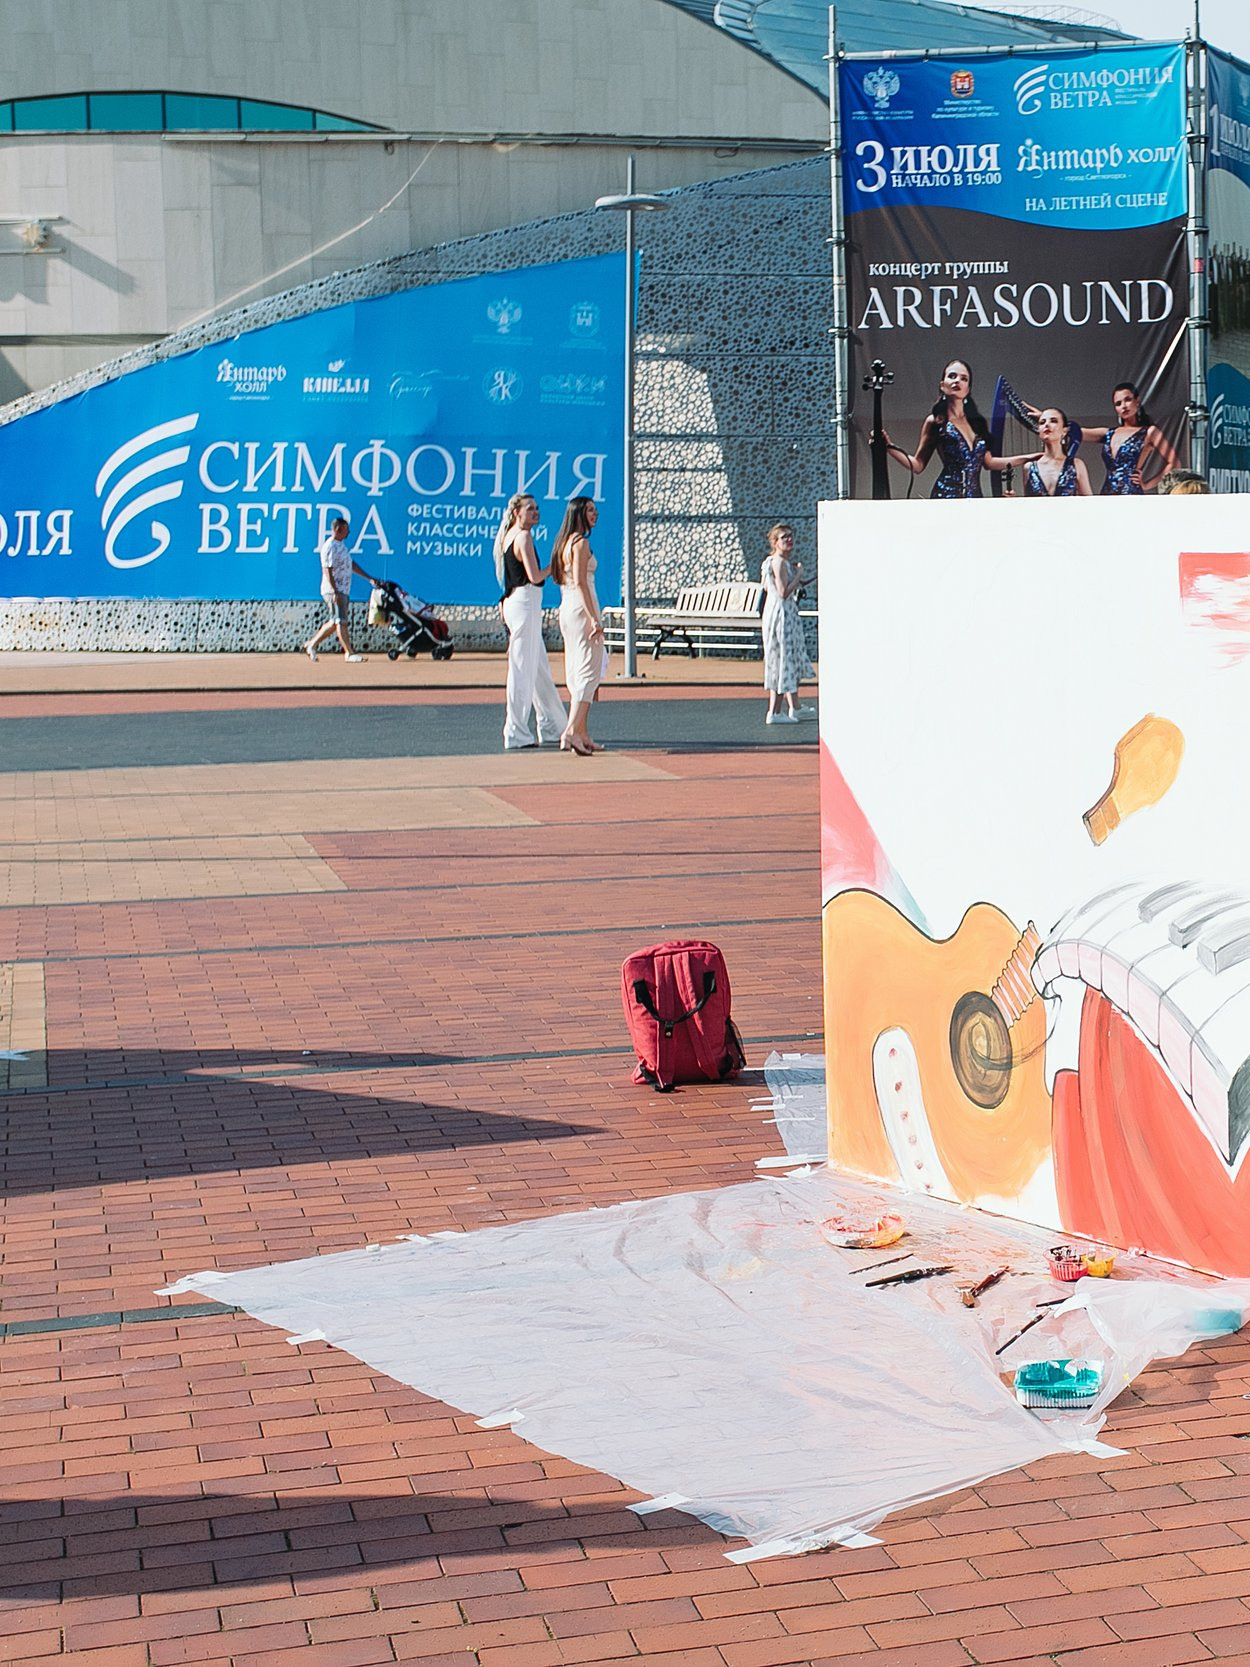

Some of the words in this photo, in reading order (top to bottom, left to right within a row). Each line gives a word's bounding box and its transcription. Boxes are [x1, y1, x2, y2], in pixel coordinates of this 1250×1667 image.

[1048, 65, 1174, 90] СИМФОНИЯ
[1050, 90, 1112, 110] ВЕТРА
[855, 140, 887, 193] 3
[890, 143, 1001, 174] ИЮЛЯ
[1016, 138, 1123, 179] Янтарь
[892, 174, 950, 188] НАЧАЛО
[954, 173, 963, 187] В
[967, 172, 1002, 186] 19:00
[1025, 198, 1047, 212] НА
[1050, 192, 1112, 211] ЛЕТНЕЙ
[1115, 192, 1168, 209] СЦЕНЕ
[868, 262, 941, 280] концерт
[945, 260, 1009, 279] группы
[857, 279, 1175, 329] ARFASOUND
[216, 358, 287, 387] Янтарь
[199, 439, 608, 502] СИМФОНИЯ
[0, 509, 74, 557] ЛЯ
[197, 503, 394, 555] ВЕТРА
[406, 540, 482, 557] МУЗЫКИ
